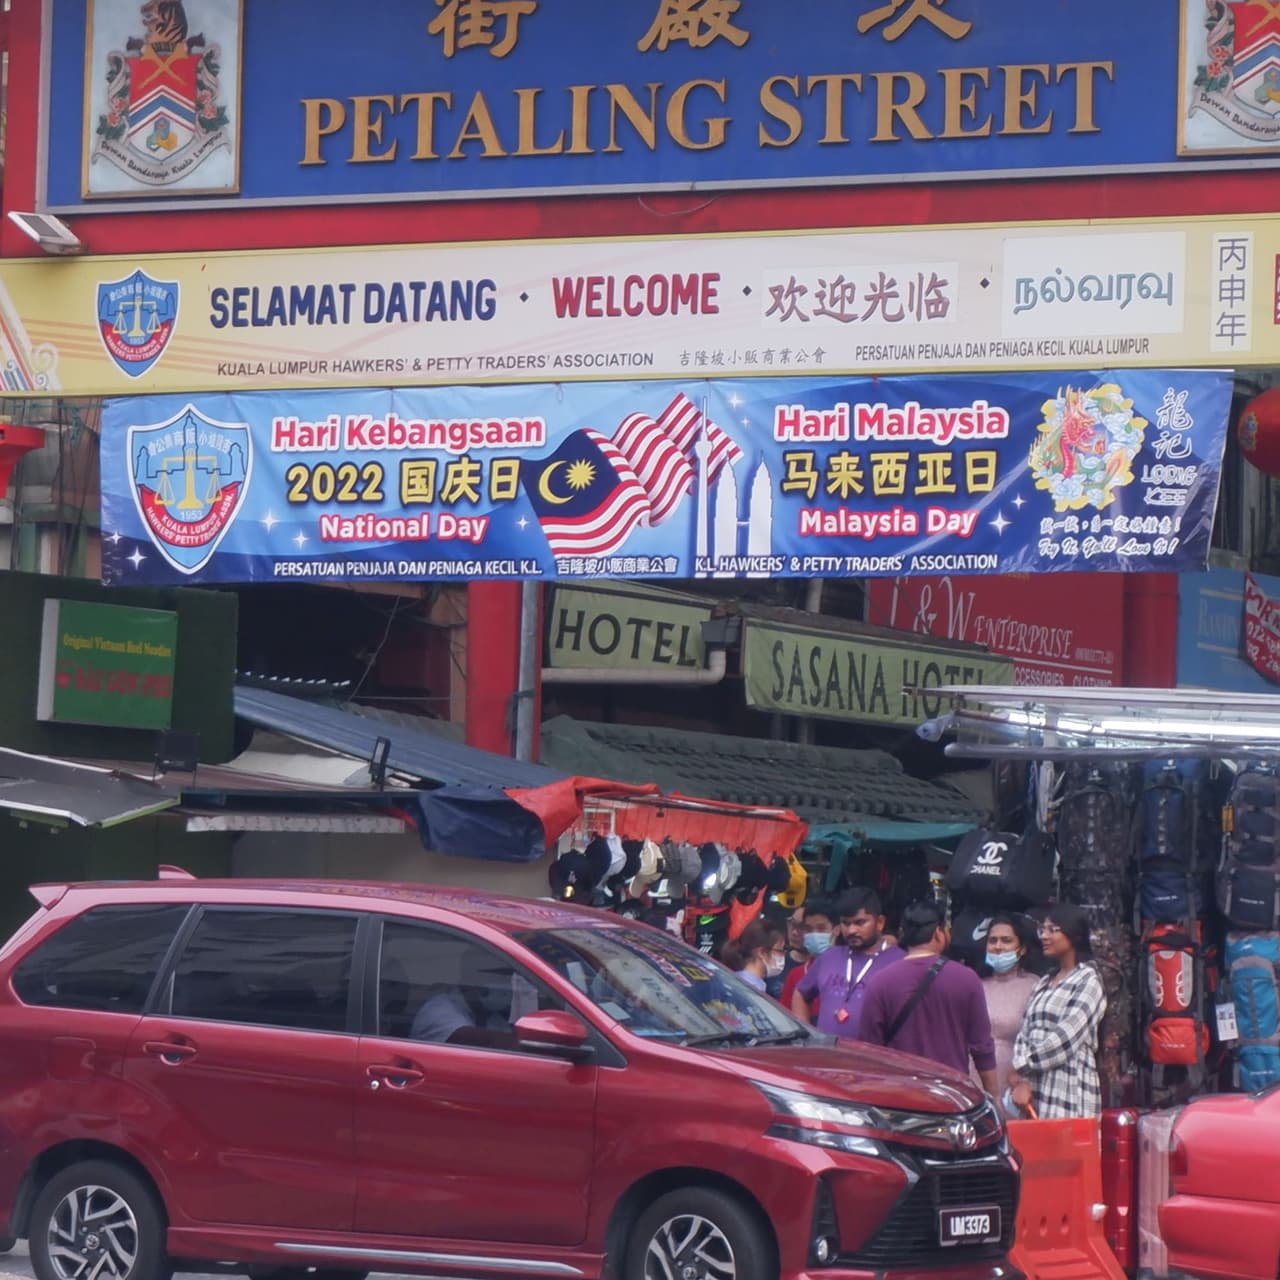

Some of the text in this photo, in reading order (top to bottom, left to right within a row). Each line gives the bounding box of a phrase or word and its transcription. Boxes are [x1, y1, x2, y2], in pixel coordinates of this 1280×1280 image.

[298, 60, 1114, 166] PETALING STREET
[210, 272, 720, 328] SELAMAT DATANG WELCOME
[764, 271, 951, 323] 欢迎光临
[1013, 266, 1174, 314] நல்வரவு
[1215, 237, 1249, 347] 丙申年
[217, 362, 265, 376] KUALA
[269, 360, 328, 375] LUMPUR
[412, 358, 422, 370] &
[426, 357, 473, 370] PETTY
[553, 352, 654, 369] ASSOCIATION
[855, 337, 1150, 361] PERSATUAN PENJAJA DAN PENIAGA KECIL KUALA LUMPUR
[274, 417, 543, 451] Hari Kebangsaan
[777, 407, 1007, 442] Hari Malaysia
[287, 457, 521, 505] 2022 国庆日
[783, 451, 998, 499] 马来西亚日
[321, 514, 488, 542] National Day
[800, 508, 977, 538] Malaysia Day
[274, 560, 543, 576] PERSATUAN PENJAJA DAN PENIAGA KECIL K.L.
[790, 558, 800, 571] &
[803, 557, 843, 571] PETTY
[910, 553, 999, 570] ASSOCIATION
[555, 608, 696, 667] HOTEL
[974, 614, 1073, 659] ENTERPRISE
[771, 639, 890, 714] SASANA
[1014, 667, 1064, 687] CCESSORIES
[970, 865, 1001, 875] CHANEL
